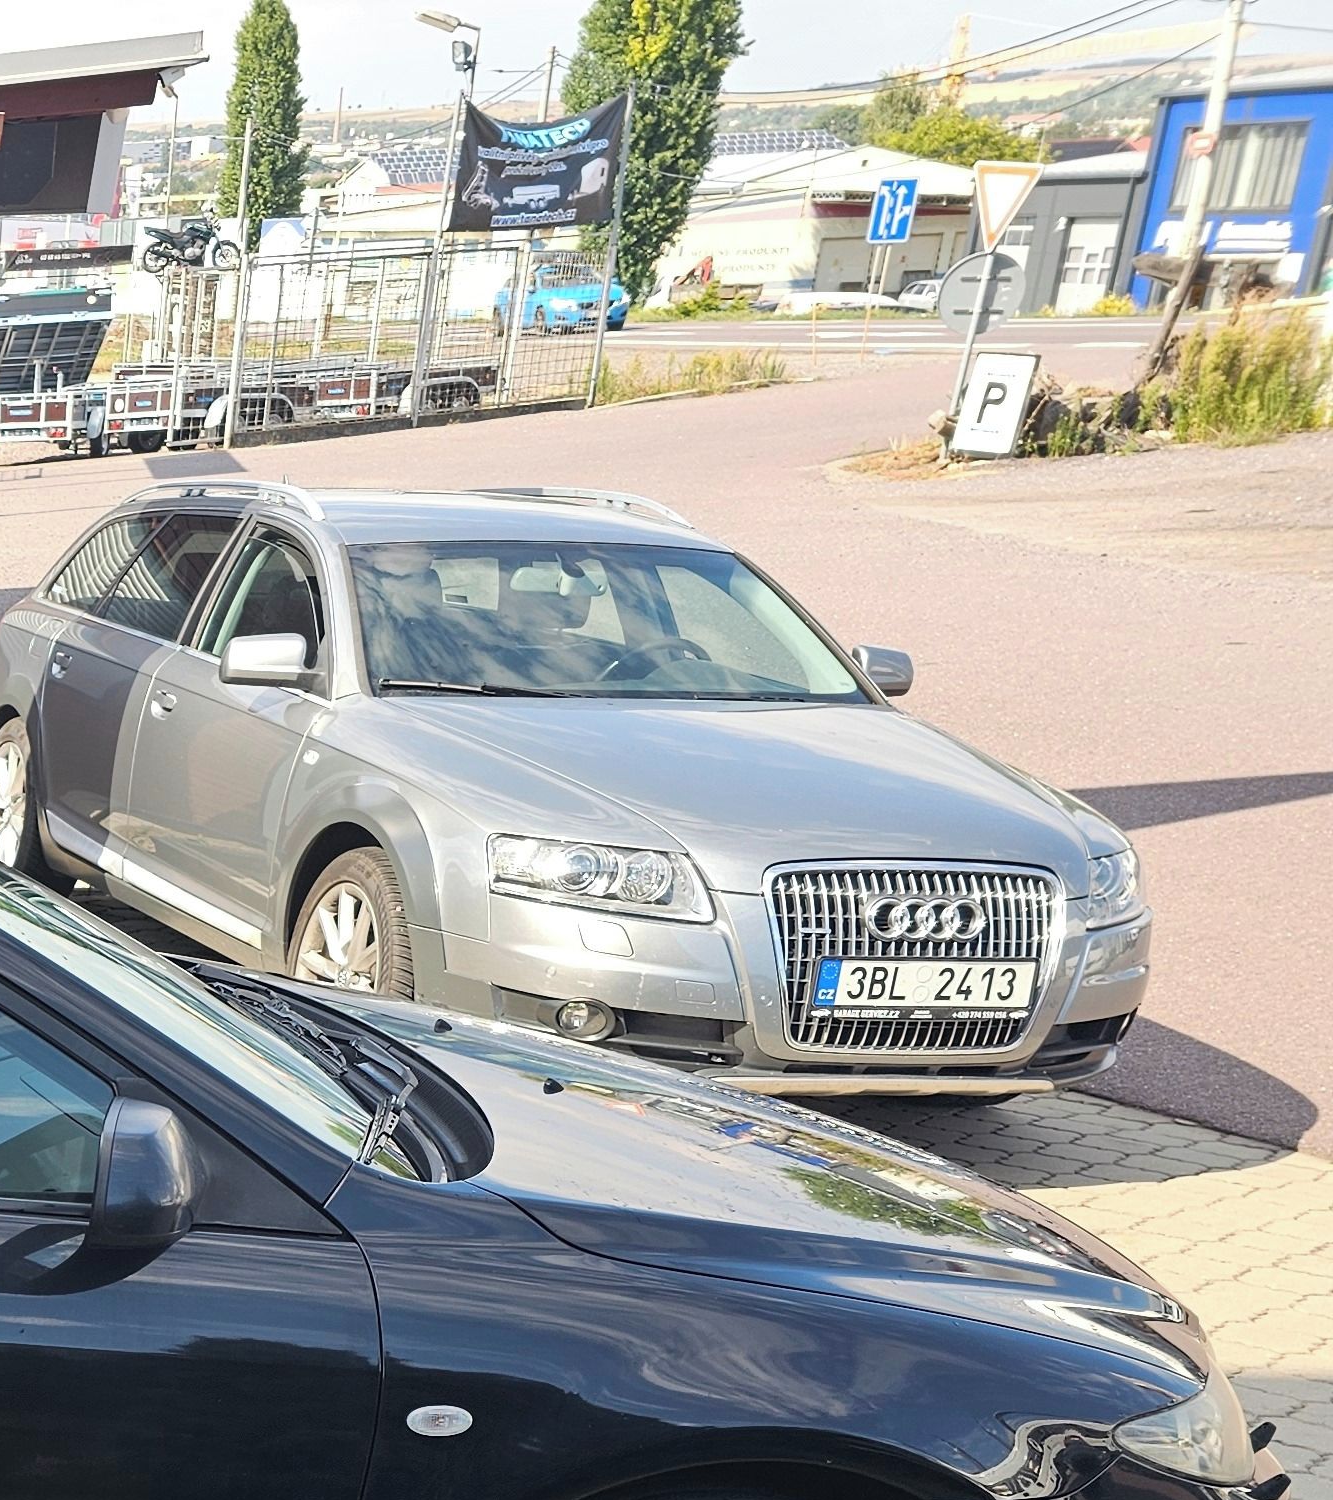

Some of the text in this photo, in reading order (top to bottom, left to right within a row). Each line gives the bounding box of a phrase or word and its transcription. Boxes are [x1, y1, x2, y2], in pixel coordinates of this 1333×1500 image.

[976, 381, 1008, 424] P
[817, 988, 834, 1000] CZ
[846, 966, 1017, 1001] 3BL 2413
